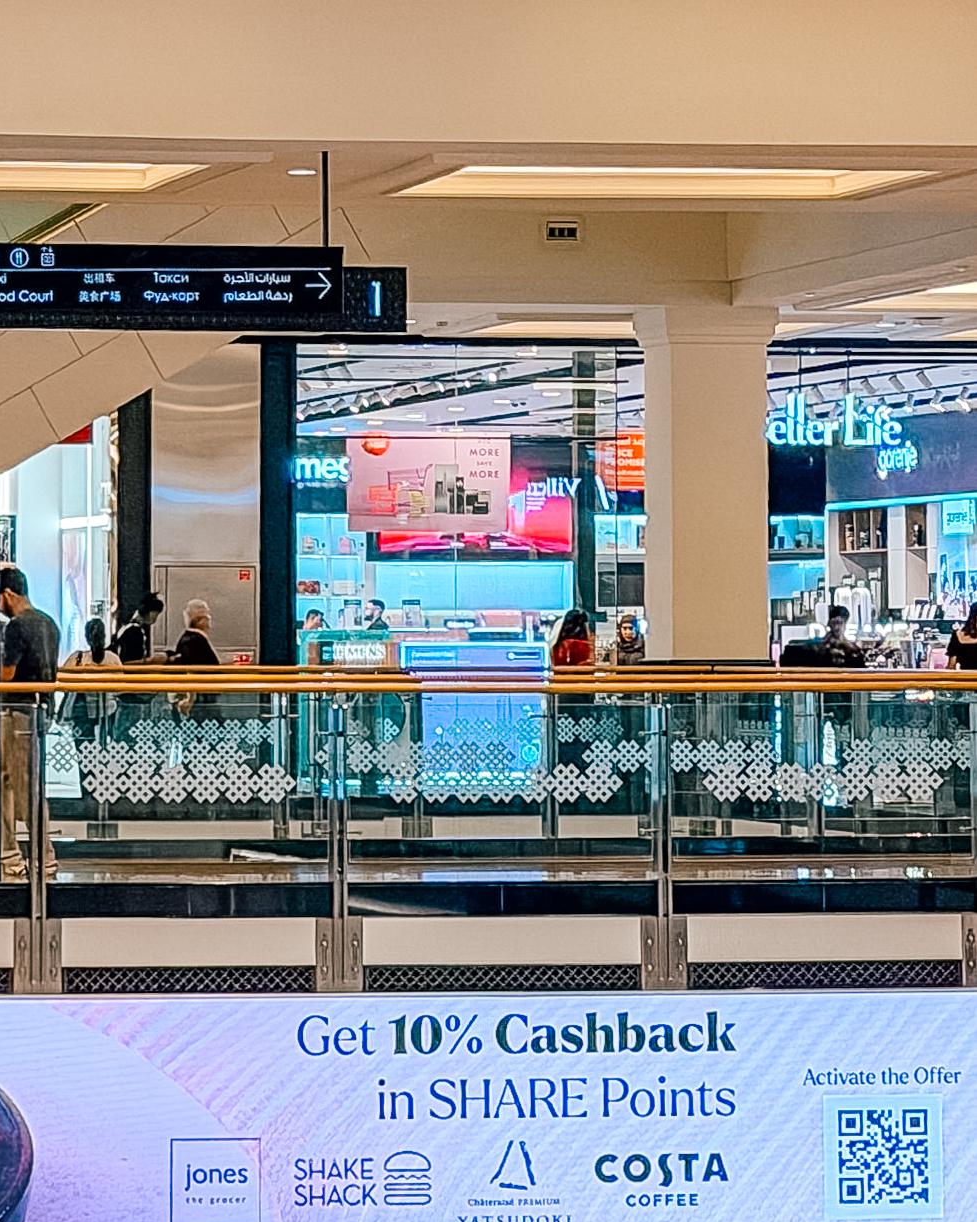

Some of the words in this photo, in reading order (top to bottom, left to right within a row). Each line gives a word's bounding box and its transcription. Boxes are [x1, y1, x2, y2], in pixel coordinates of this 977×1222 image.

[153, 271, 189, 284] Такси
[18, 289, 54, 302] Court
[143, 291, 200, 303] Фуд-корт
[371, 281, 381, 316] 1
[844, 392, 903, 446] Life
[469, 448, 500, 457] MORE
[469, 470, 500, 479] MORE
[297, 1014, 376, 1056] Get
[388, 1013, 483, 1055] 10%
[495, 1011, 737, 1055] Cashback
[803, 1067, 876, 1086] Activate
[881, 1067, 909, 1085] the
[914, 1066, 961, 1084] Offer
[378, 1078, 415, 1120] in
[429, 1078, 588, 1120] SHARE
[602, 1076, 737, 1118] Points
[184, 1163, 249, 1192] jones
[293, 1158, 374, 1180] SHAKE
[594, 1153, 729, 1187] COSTA
[293, 1183, 377, 1207] SHACK
[625, 1193, 699, 1207] COFFEE
